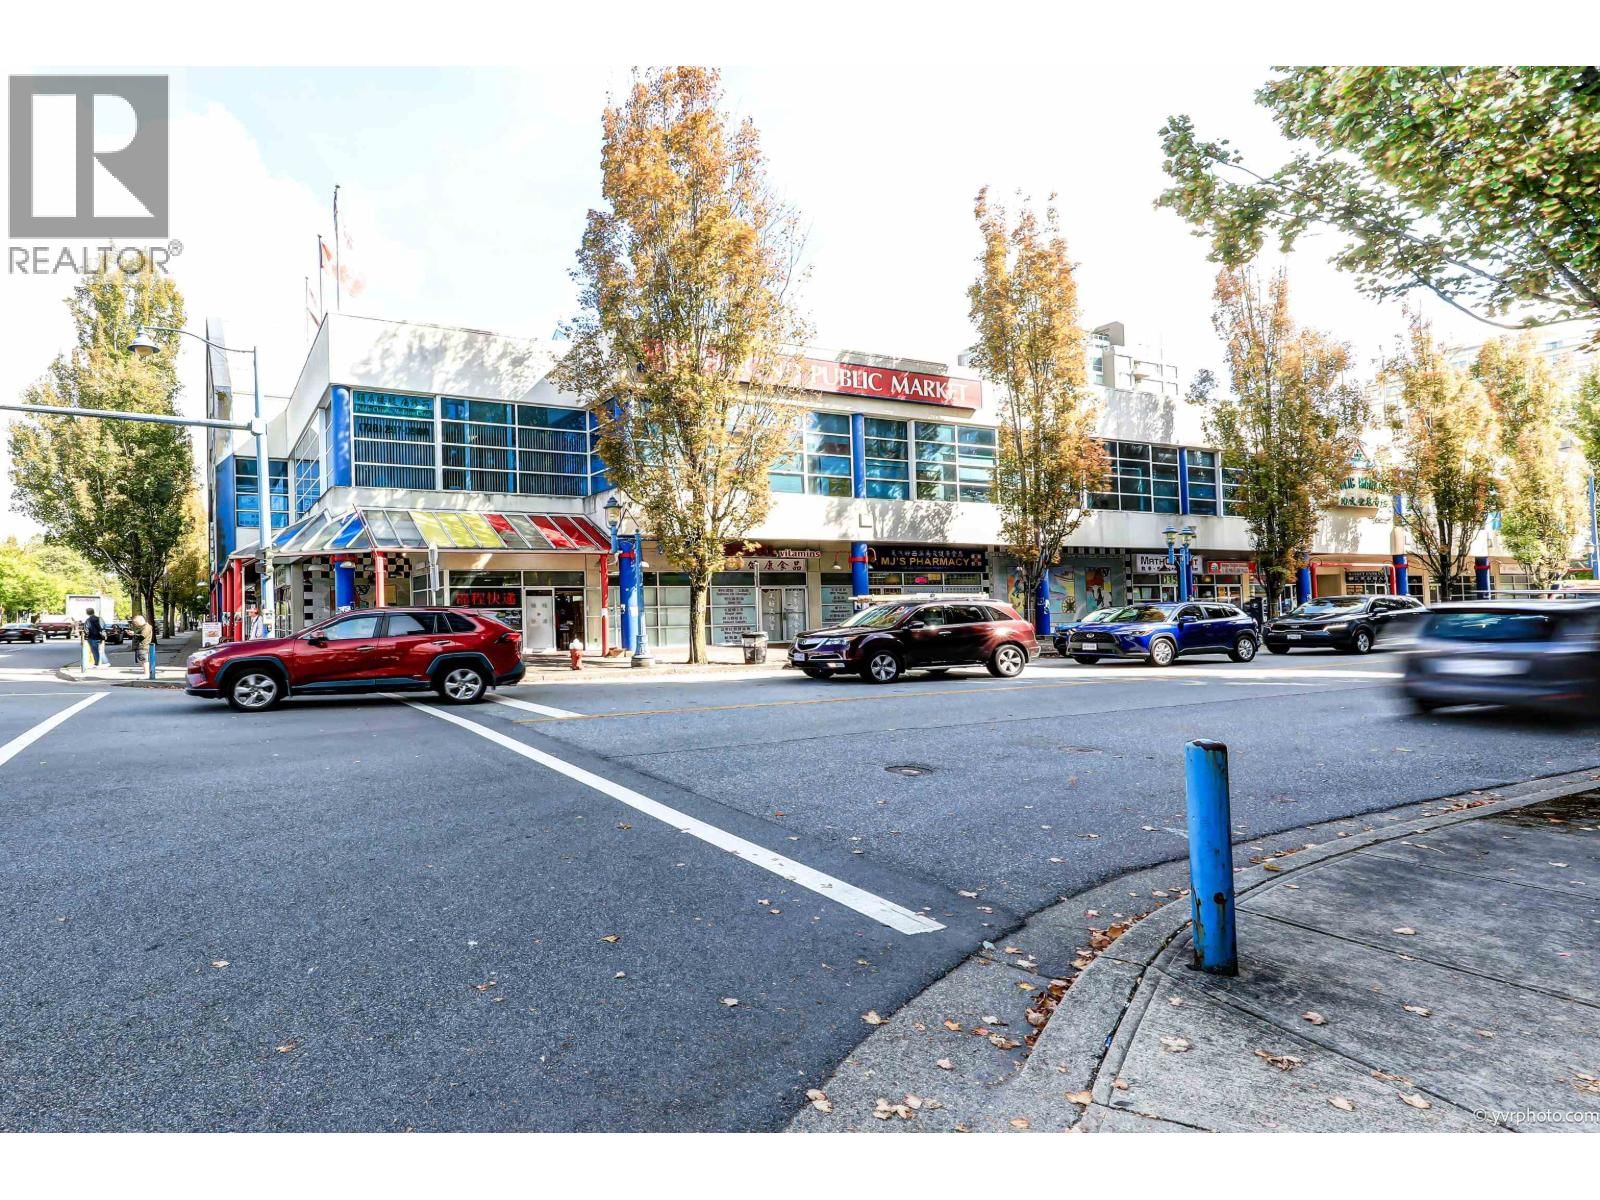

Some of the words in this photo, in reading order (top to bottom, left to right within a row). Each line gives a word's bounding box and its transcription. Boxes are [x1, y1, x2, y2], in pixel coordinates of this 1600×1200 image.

[811, 364, 882, 392] PUBLIC
[891, 373, 968, 401] MARKET
[779, 549, 820, 558] vitamins
[881, 557, 906, 566] MJ'S
[909, 557, 970, 567] PHARMACY
